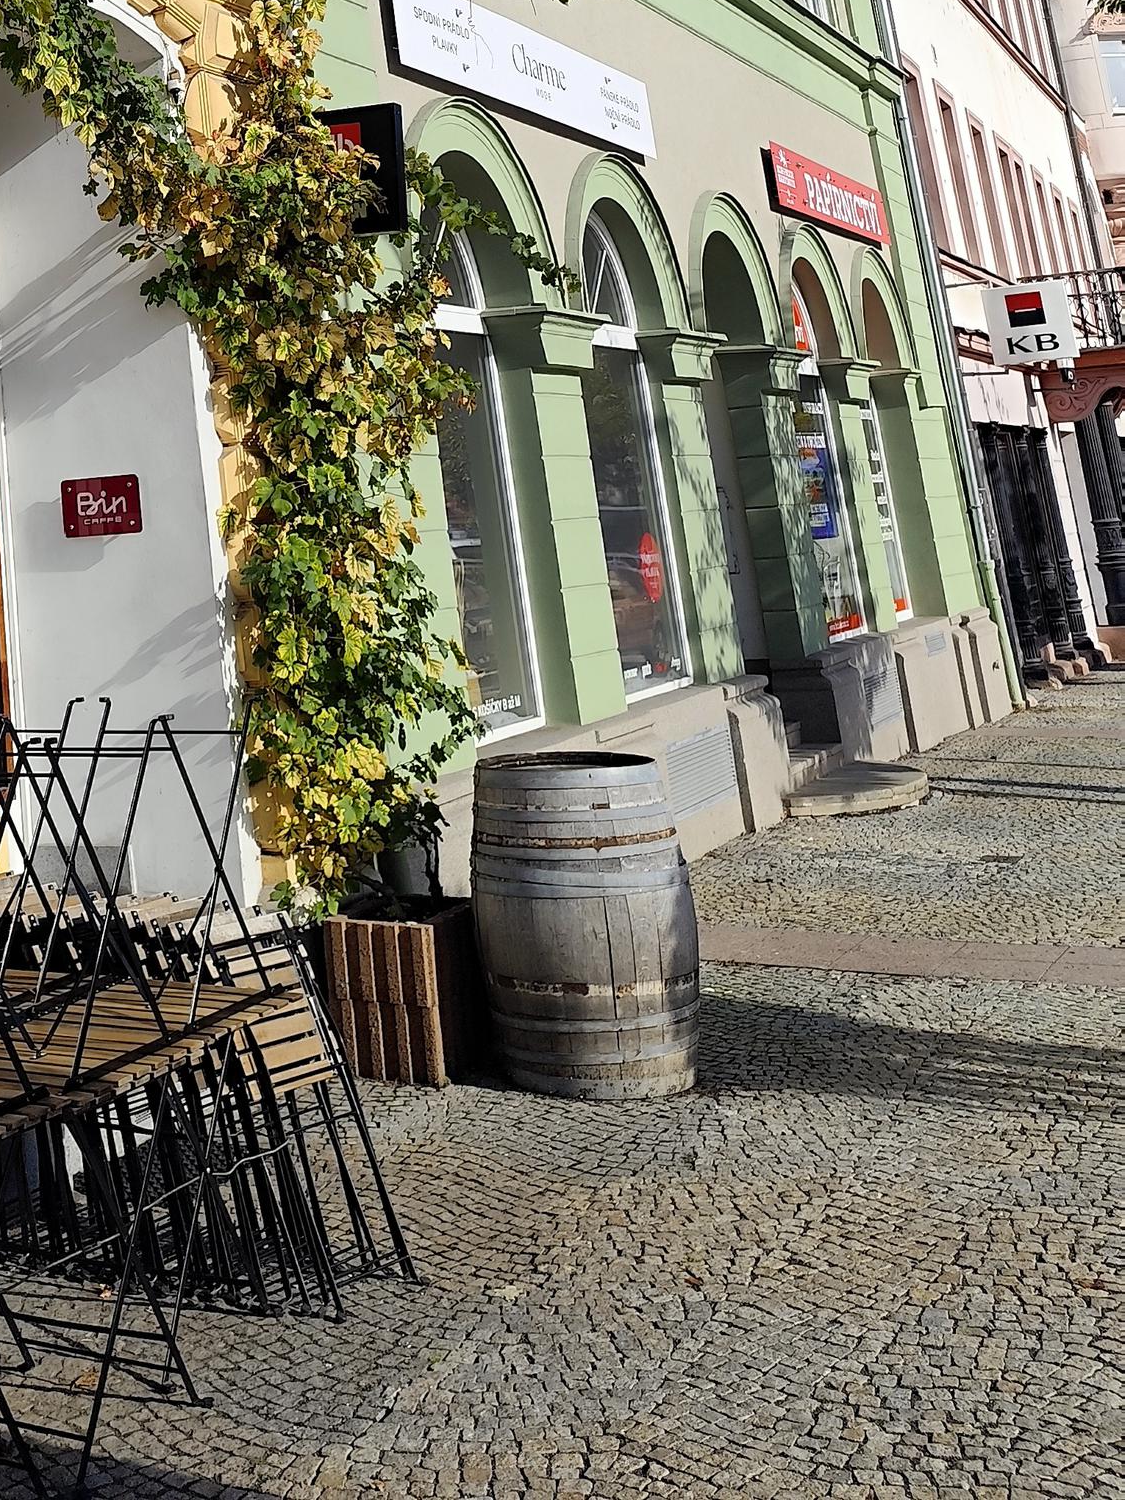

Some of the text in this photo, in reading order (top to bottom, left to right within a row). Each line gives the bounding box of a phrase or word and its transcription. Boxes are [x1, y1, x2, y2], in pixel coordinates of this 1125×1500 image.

[413, 6, 470, 40] SPODNÍ PRÁDLO
[432, 35, 458, 56] PLAVKY
[512, 43, 567, 91] Charme
[803, 172, 883, 236] PAPÍRNICTVÍ
[1005, 333, 1060, 355] KB
[77, 490, 127, 516] Bin
